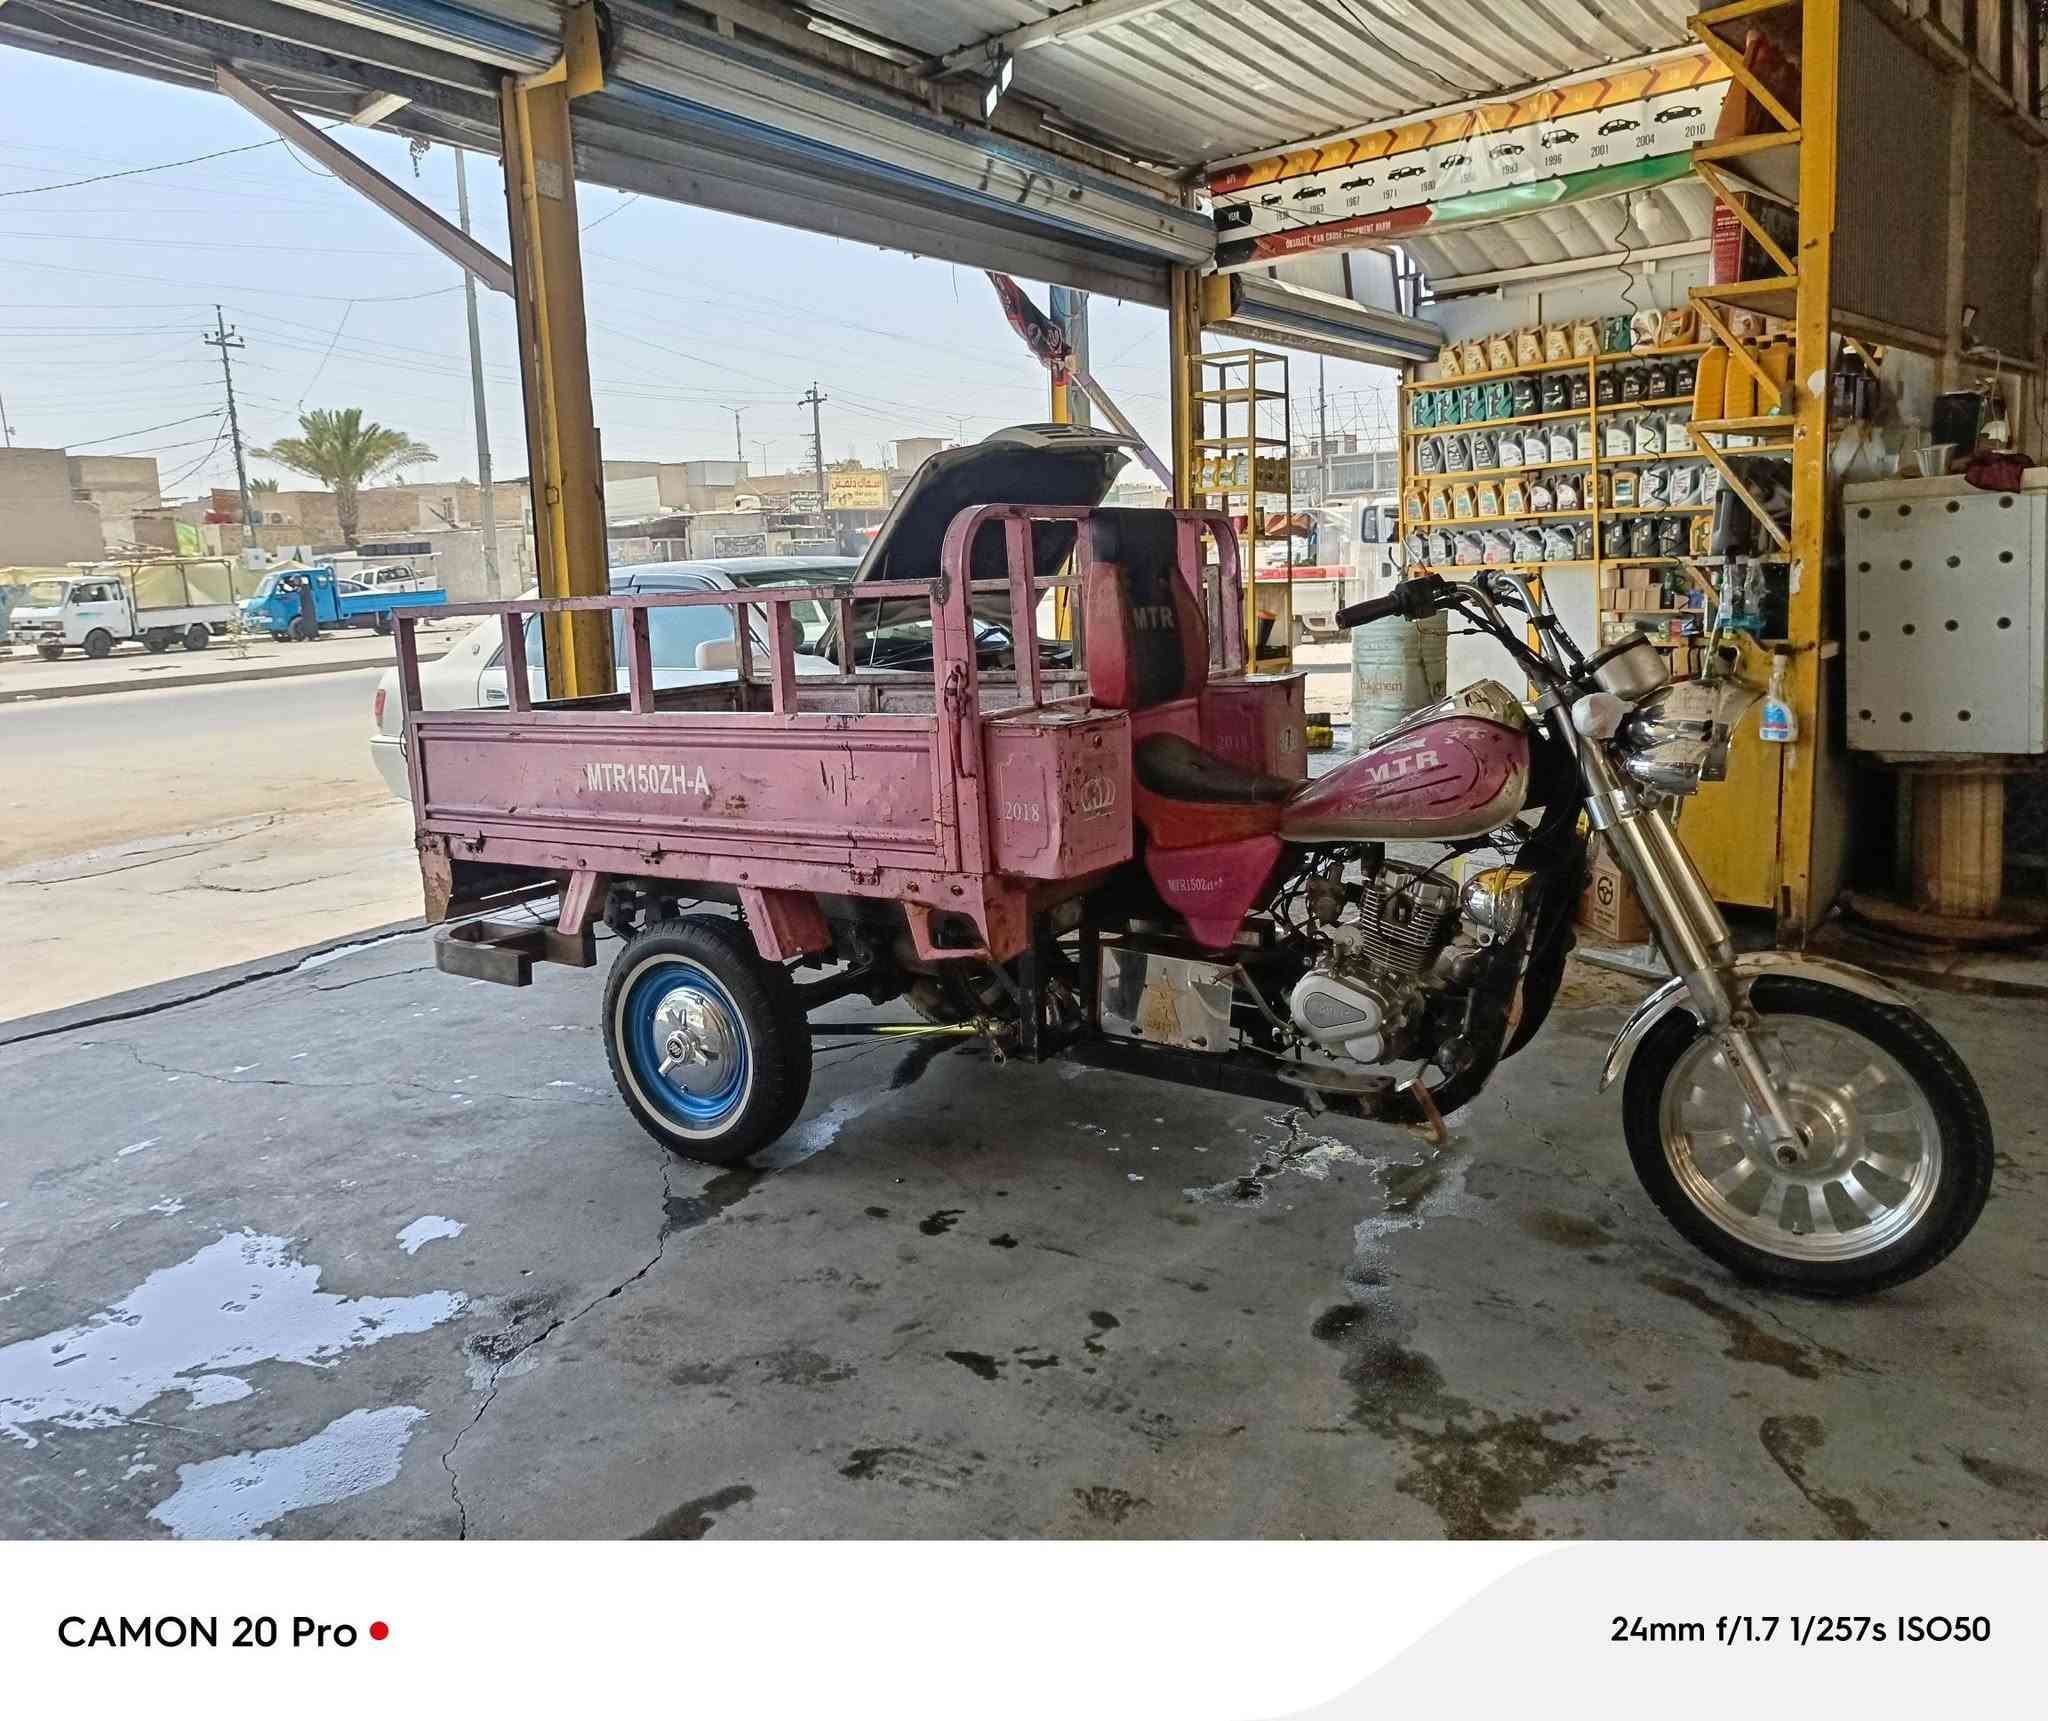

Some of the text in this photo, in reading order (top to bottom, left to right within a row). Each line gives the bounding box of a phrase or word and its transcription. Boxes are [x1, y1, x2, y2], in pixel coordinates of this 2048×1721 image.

[1545, 153, 1563, 167] 1996
[1590, 144, 1609, 158] 2001
[1636, 133, 1655, 148] 2004
[1684, 123, 1706, 138] 2010
[1133, 606, 1175, 630] MTR
[586, 763, 711, 796] MTR150ZH-A
[1365, 750, 1440, 785] MTR
[1005, 800, 1040, 822] 2018
